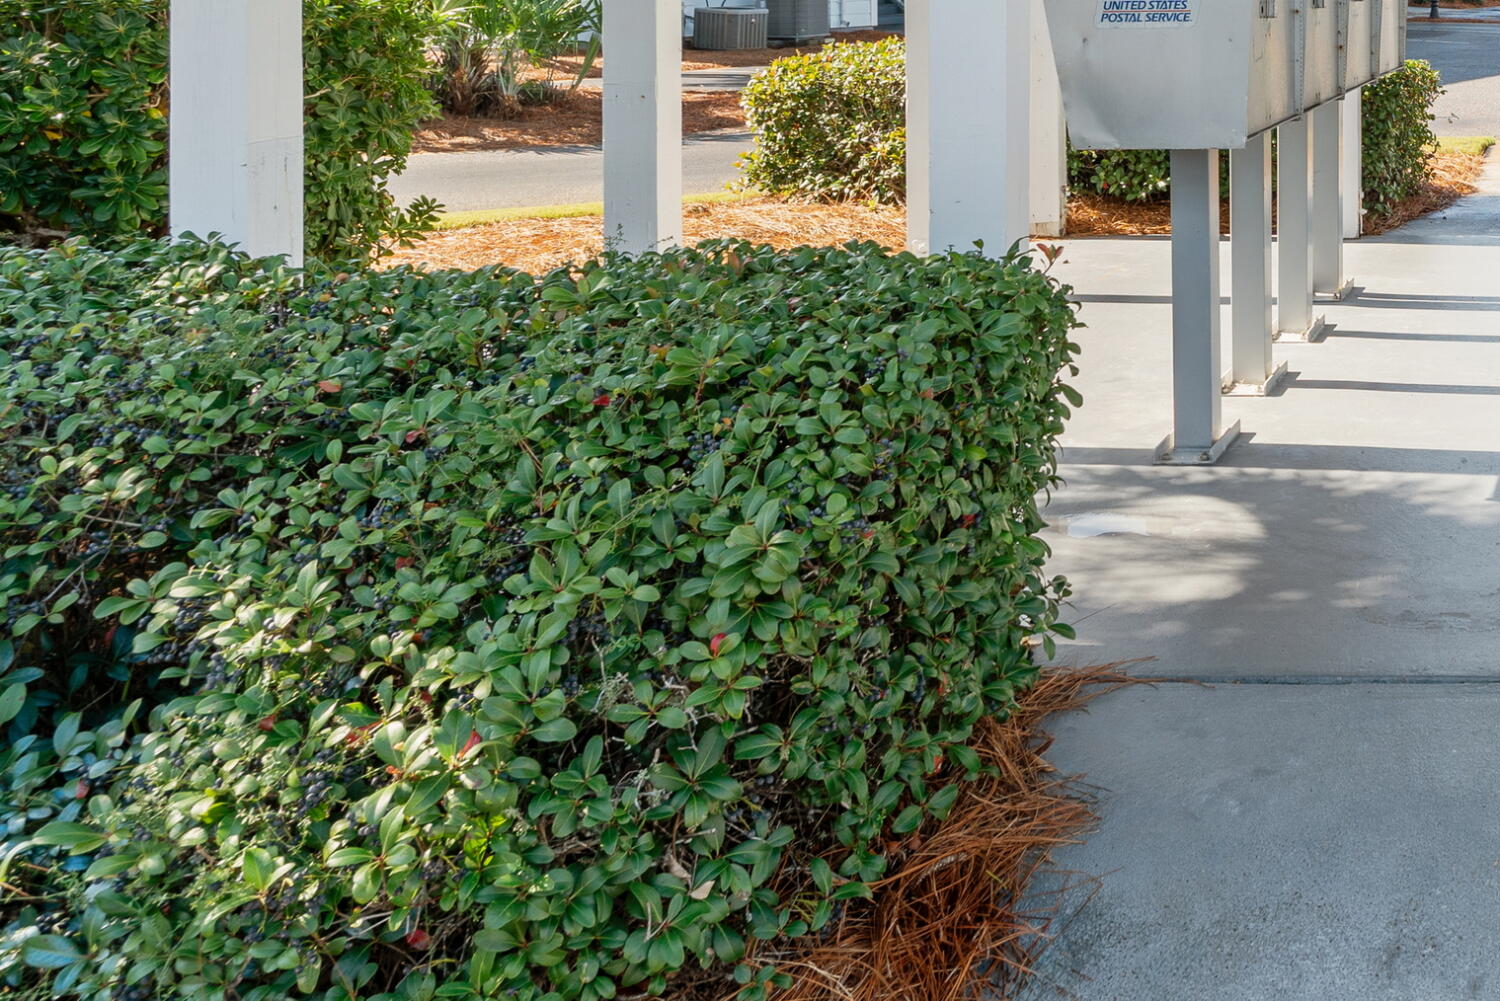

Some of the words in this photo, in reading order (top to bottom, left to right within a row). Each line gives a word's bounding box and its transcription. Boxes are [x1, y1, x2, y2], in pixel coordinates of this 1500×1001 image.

[1103, 0, 1147, 11] UNITED
[1148, 0, 1188, 10] STATES
[1100, 12, 1143, 23] POSTAL
[1144, 12, 1191, 23] SERVICE
